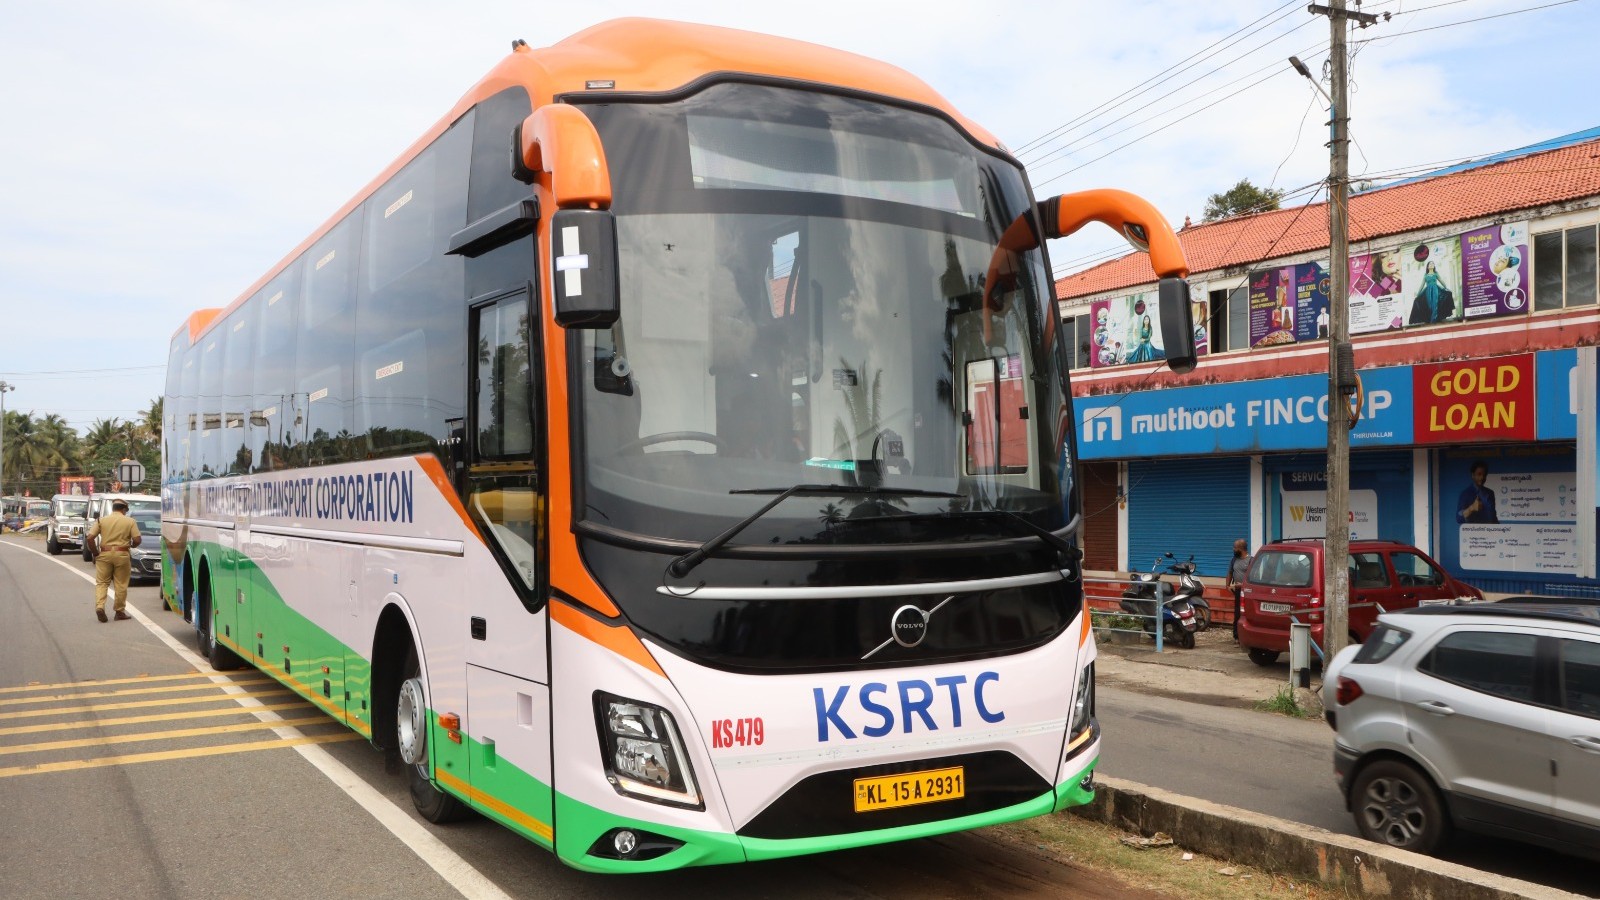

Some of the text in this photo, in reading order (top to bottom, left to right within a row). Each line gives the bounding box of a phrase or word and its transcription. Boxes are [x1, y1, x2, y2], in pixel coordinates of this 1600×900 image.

[1468, 234, 1492, 244] Hydra
[1470, 241, 1490, 250] Facial
[1430, 365, 1520, 396] GOLD
[1132, 402, 1236, 434] muthoot
[1430, 401, 1516, 432] LOAN
[263, 478, 313, 518] TRANSPORT
[316, 470, 412, 524] CORPORATION
[1306, 514, 1322, 522] Union
[812, 671, 1006, 742] KSRTC
[712, 717, 764, 748] KS479
[867, 784, 886, 804] KL
[892, 782, 910, 801] 15
[914, 780, 922, 799] A
[926, 774, 960, 798] 2931
